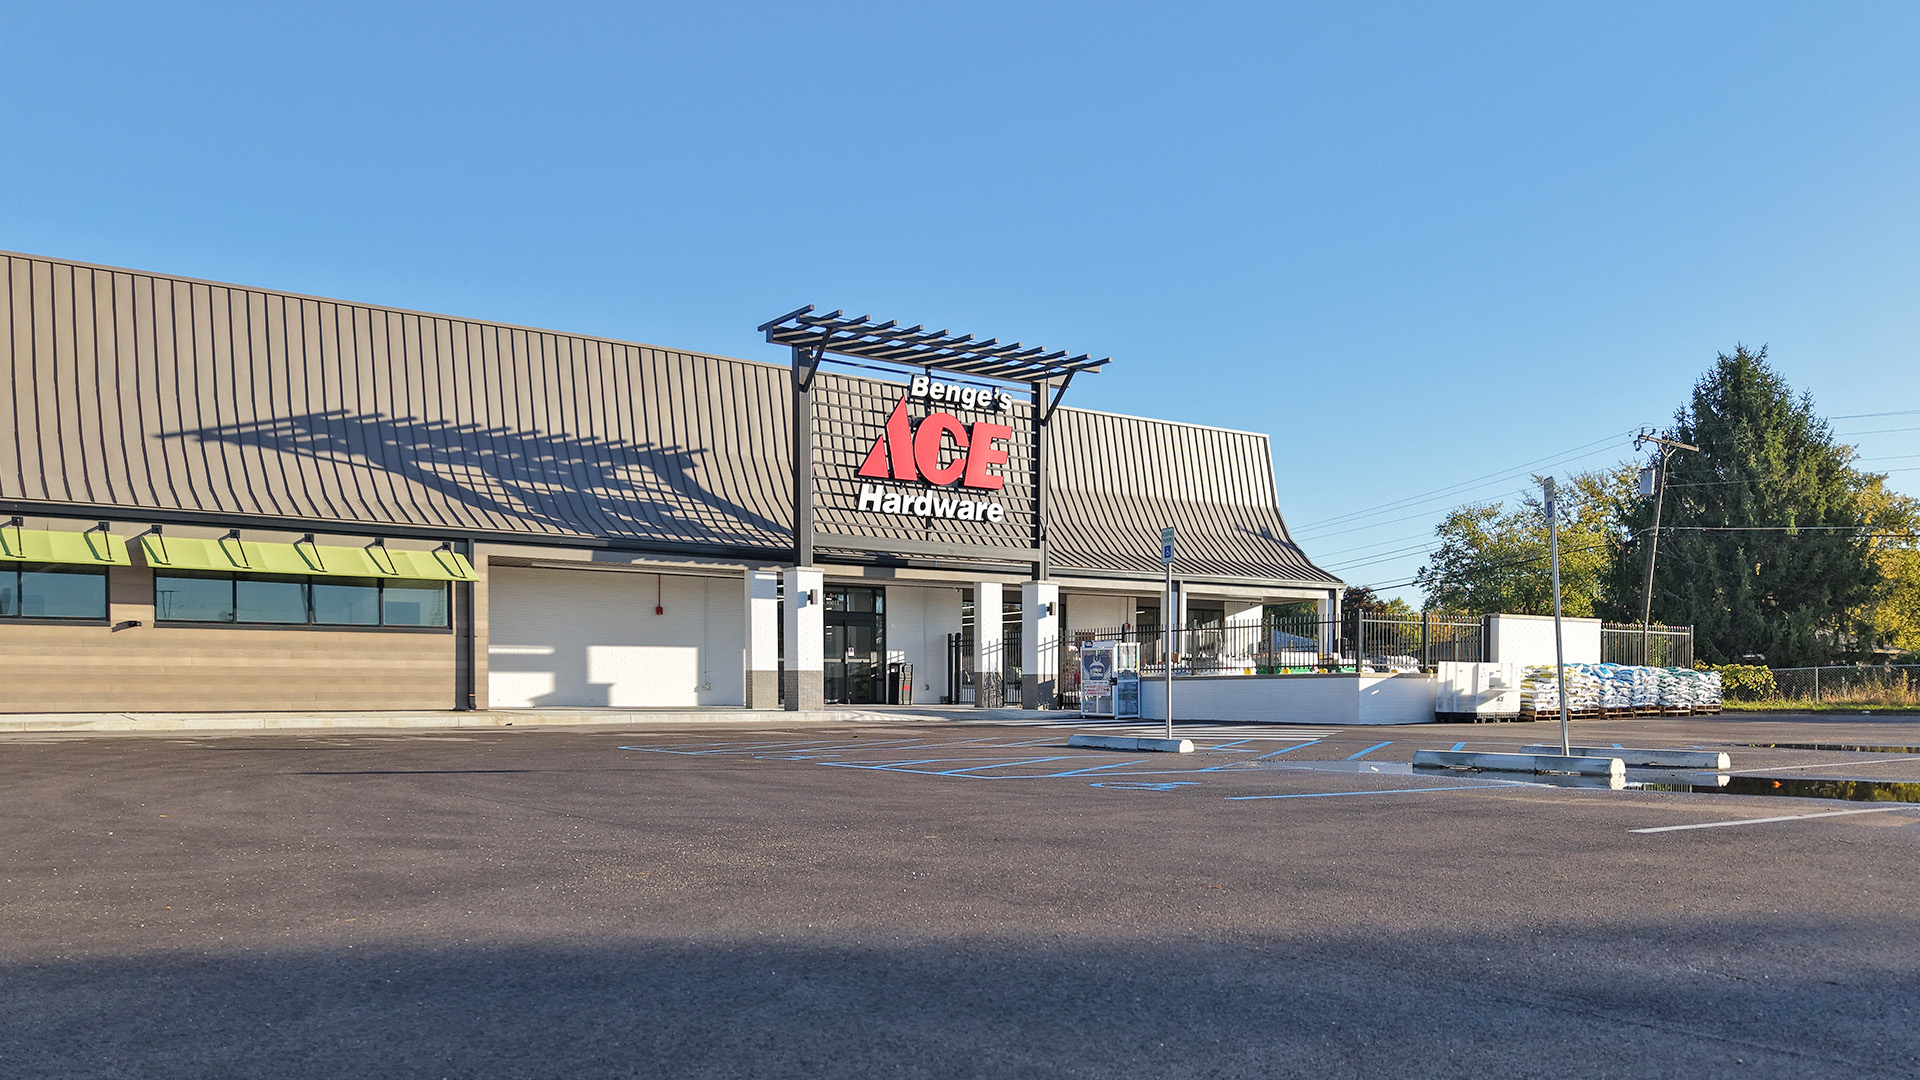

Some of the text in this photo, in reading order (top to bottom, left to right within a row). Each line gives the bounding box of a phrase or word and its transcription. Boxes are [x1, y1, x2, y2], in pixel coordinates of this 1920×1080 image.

[911, 374, 1013, 410] Benge's
[858, 395, 1013, 490] ACE
[858, 483, 1004, 523] Hardware
